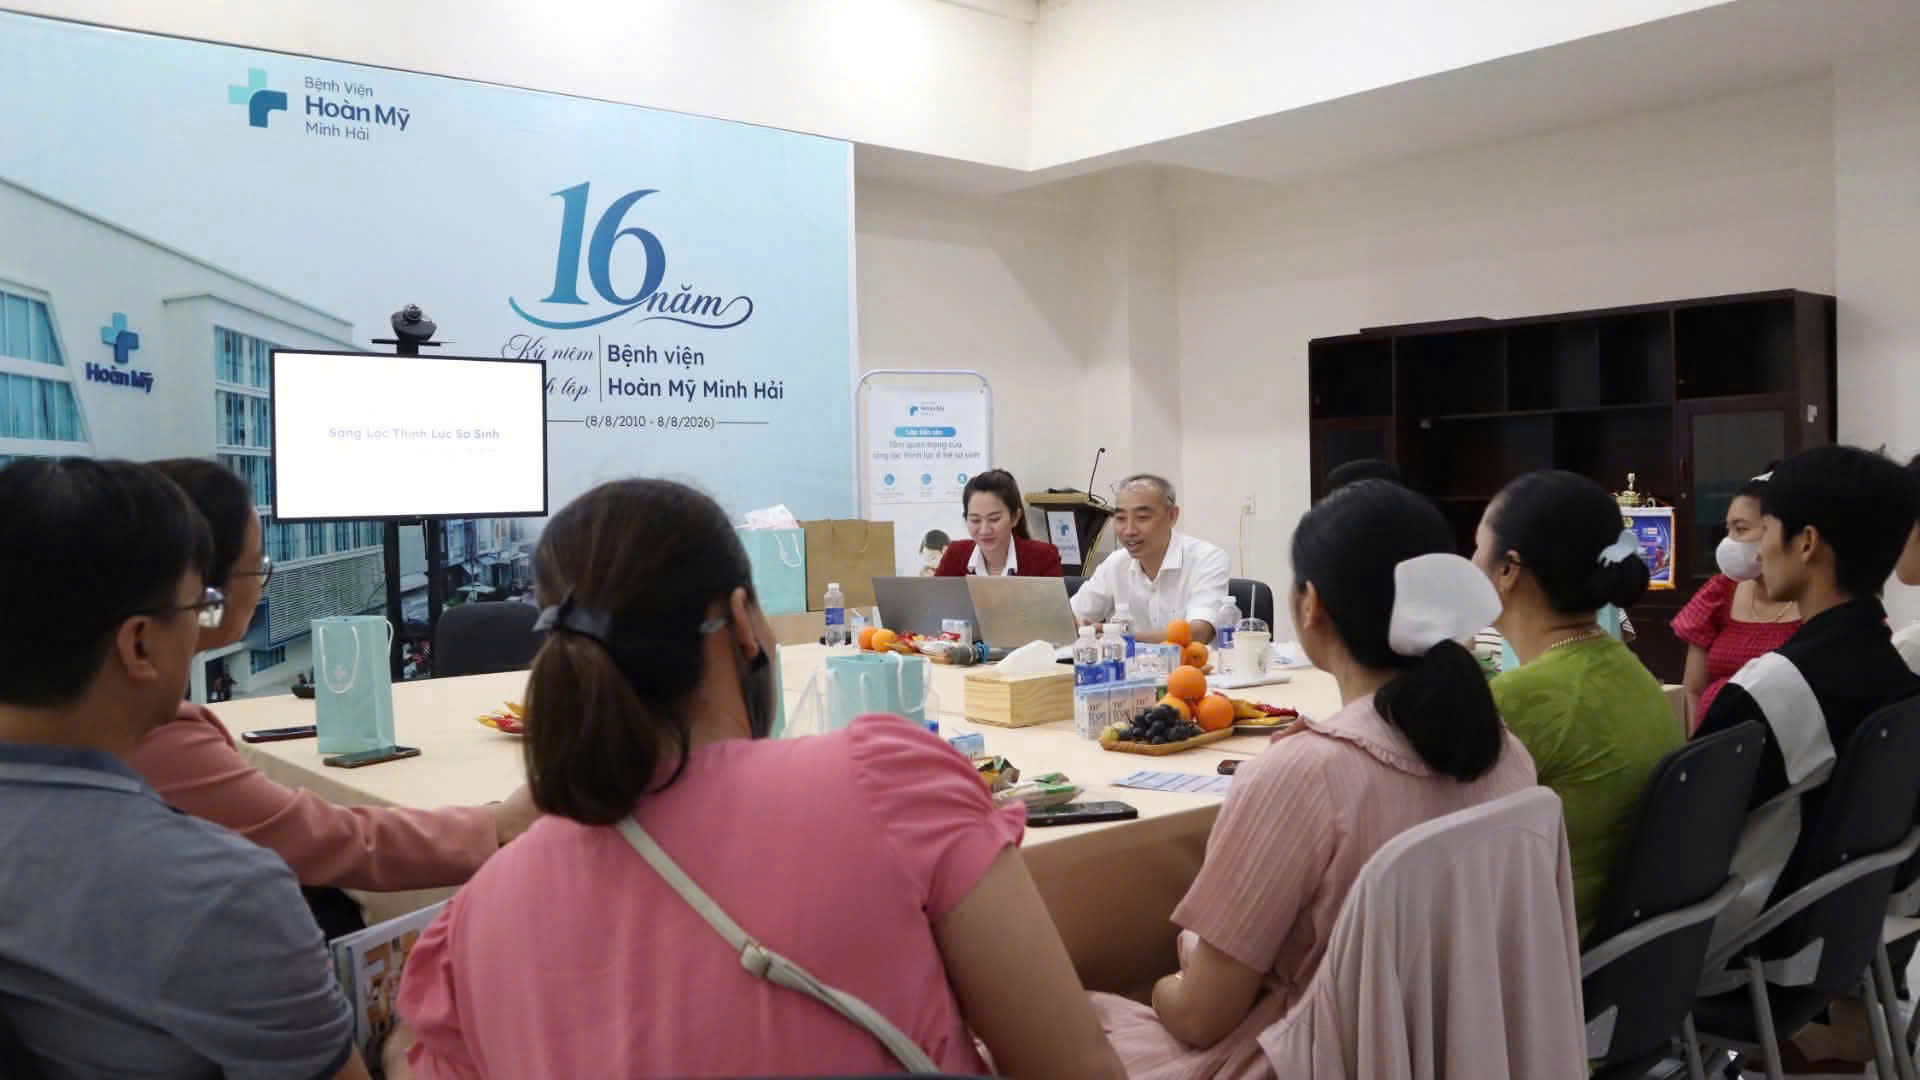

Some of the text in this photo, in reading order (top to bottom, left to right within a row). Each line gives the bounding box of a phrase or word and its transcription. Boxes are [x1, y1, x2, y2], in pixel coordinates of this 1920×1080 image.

[305, 77, 374, 97] Bệnh Viện
[305, 95, 410, 131] Hoàn Mỹ
[305, 121, 369, 141] Minh Hải
[540, 181, 666, 306] 16
[645, 282, 753, 320] năm
[607, 344, 705, 370] Bệnh viện
[608, 377, 784, 403] Hoàn Mỹ Minh Hải
[585, 415, 646, 428] (8/8/2010
[657, 416, 716, 430] 8/8/2026)
